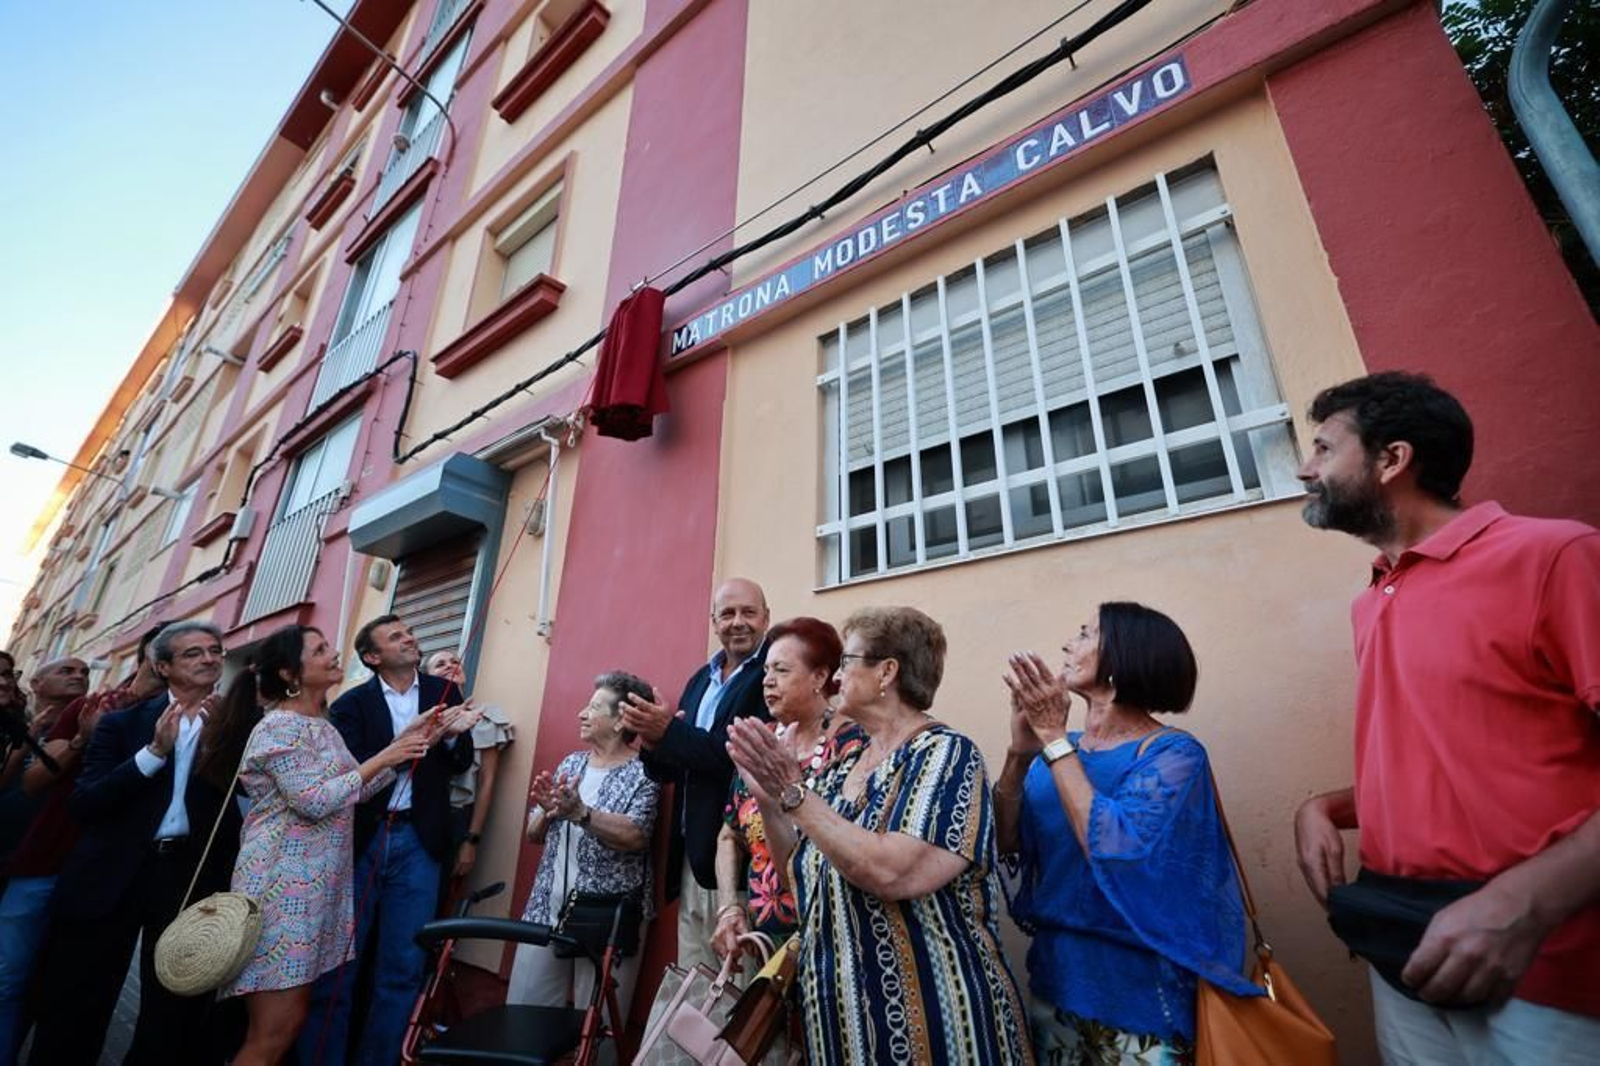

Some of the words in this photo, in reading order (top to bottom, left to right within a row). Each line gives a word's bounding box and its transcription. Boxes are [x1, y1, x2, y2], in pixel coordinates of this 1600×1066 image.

[671, 274, 791, 355] MATRONA
[813, 172, 982, 280] MODESTA
[1015, 62, 1186, 170] CALVO
